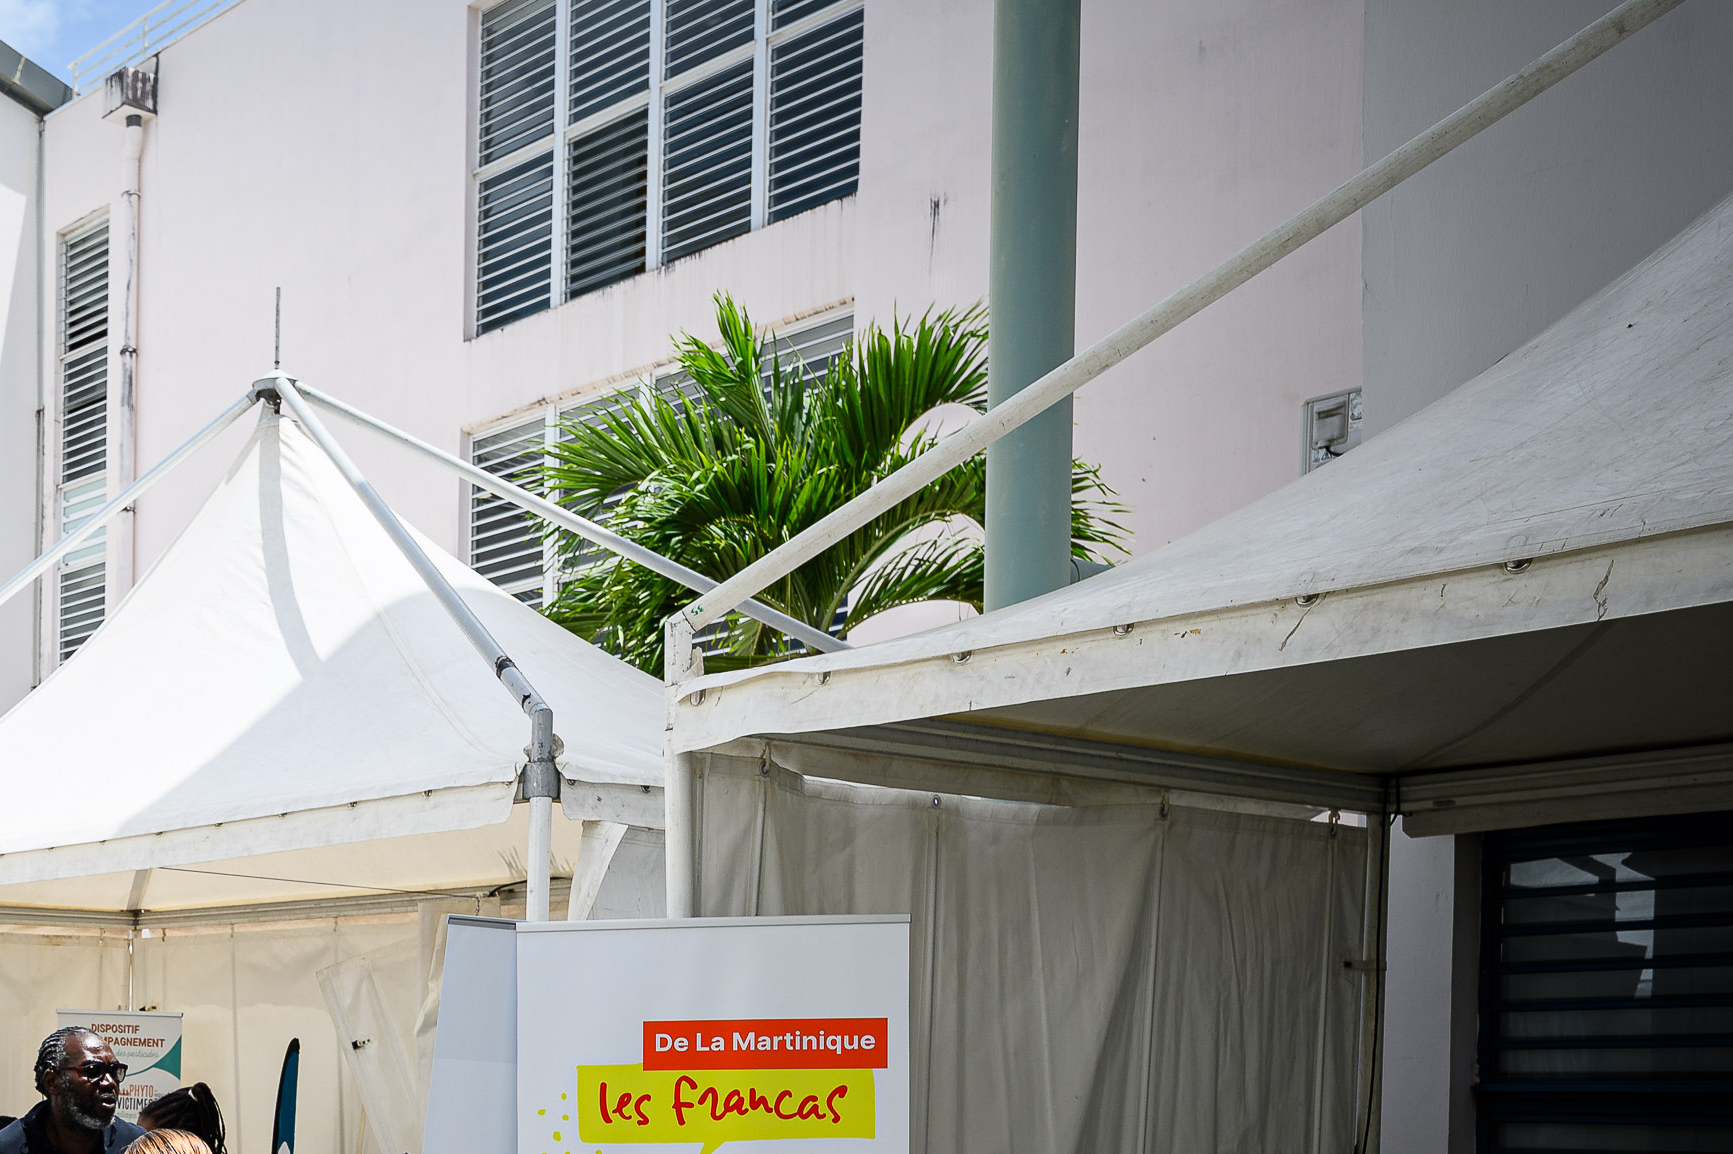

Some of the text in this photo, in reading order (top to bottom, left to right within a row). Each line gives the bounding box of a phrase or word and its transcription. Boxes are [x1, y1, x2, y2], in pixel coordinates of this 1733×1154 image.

[91, 1023, 140, 1034] DISPOSITIF
[104, 1036, 165, 1048] PAGNEMENT
[655, 1030, 876, 1055] De La Martinique
[599, 1075, 848, 1126] les francas
